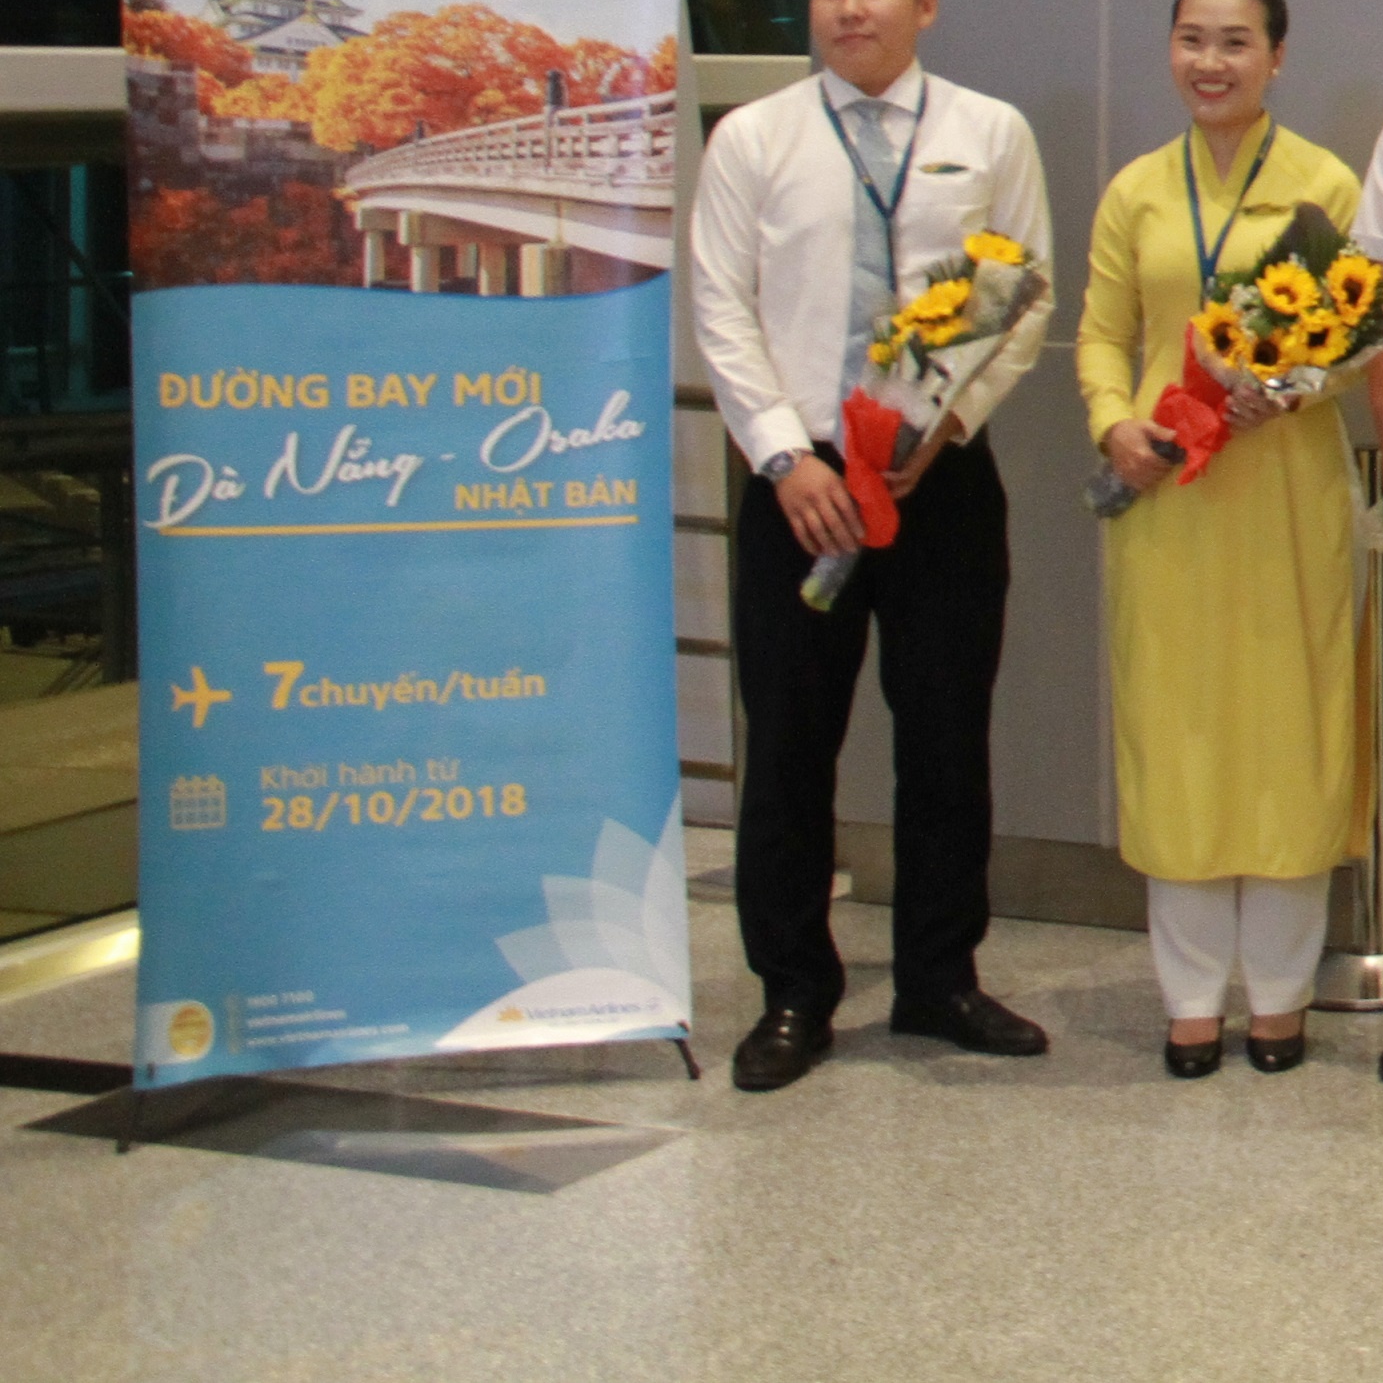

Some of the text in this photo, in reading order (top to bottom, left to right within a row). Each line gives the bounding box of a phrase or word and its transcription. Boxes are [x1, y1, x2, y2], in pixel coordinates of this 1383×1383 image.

[159, 365, 543, 410] ĐƯỜNG BAY MỚI
[480, 389, 647, 473] Osaka
[261, 782, 527, 831] 28/10/2018
